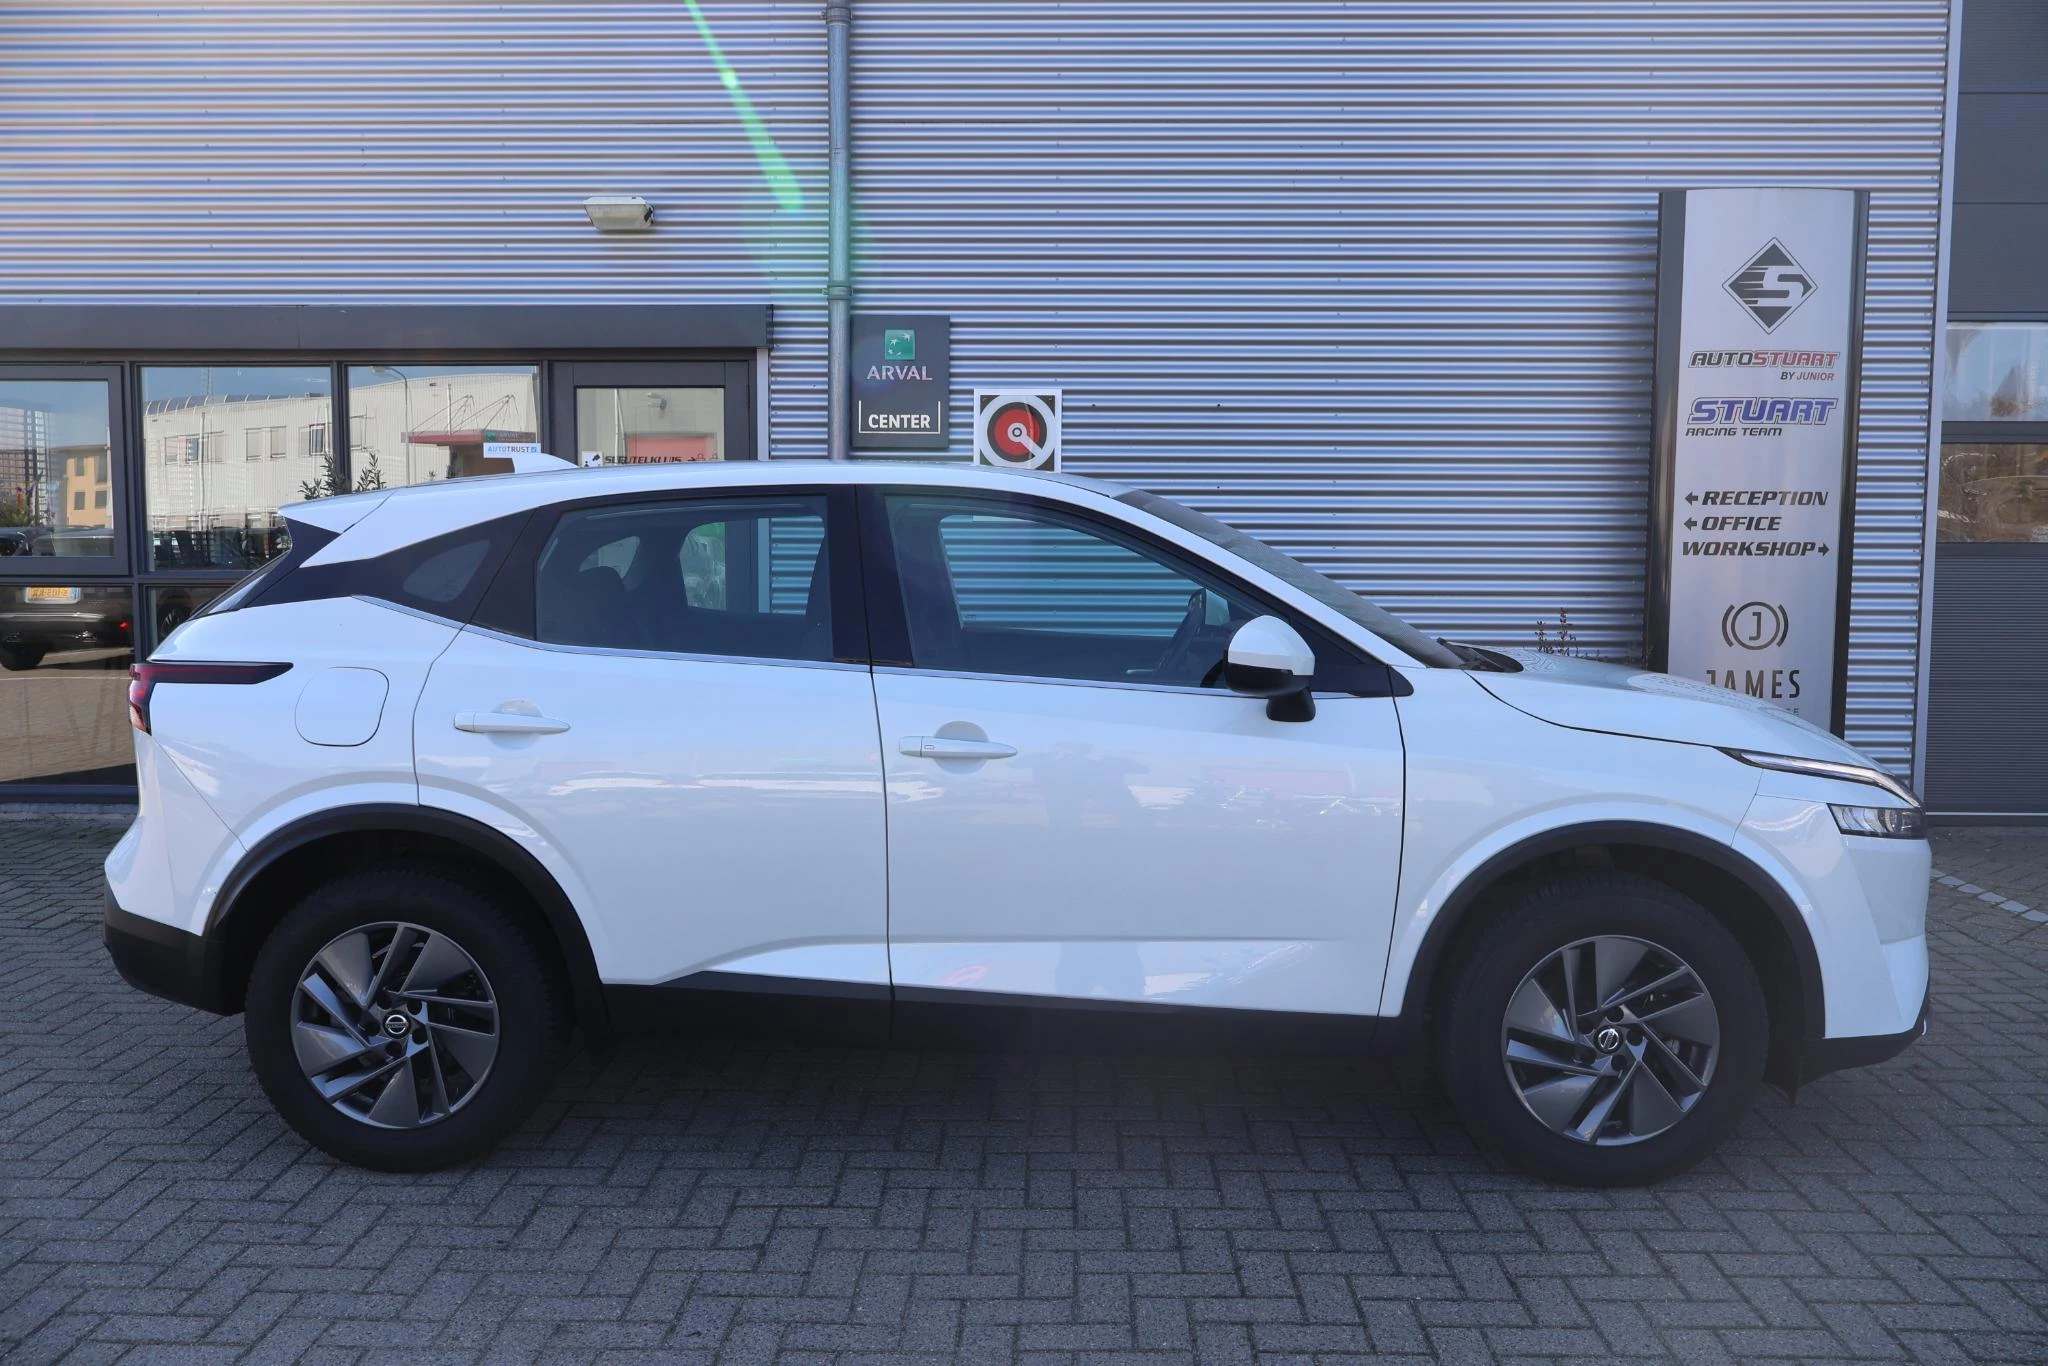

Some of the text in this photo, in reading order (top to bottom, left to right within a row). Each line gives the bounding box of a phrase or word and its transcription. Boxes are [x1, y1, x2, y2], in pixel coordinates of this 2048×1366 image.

[1689, 351, 1839, 367] AUTOSTUART
[866, 365, 933, 381] ARVAL
[1780, 371, 1835, 381] BY JUNIOR
[1688, 397, 1837, 424] STUART
[868, 414, 931, 429] CENTER
[1685, 427, 1783, 436] RACING TEAM
[1701, 491, 1829, 506] RECEPTION
[1701, 516, 1782, 531] OFFICE
[1682, 541, 1817, 556] WORKSHOP
